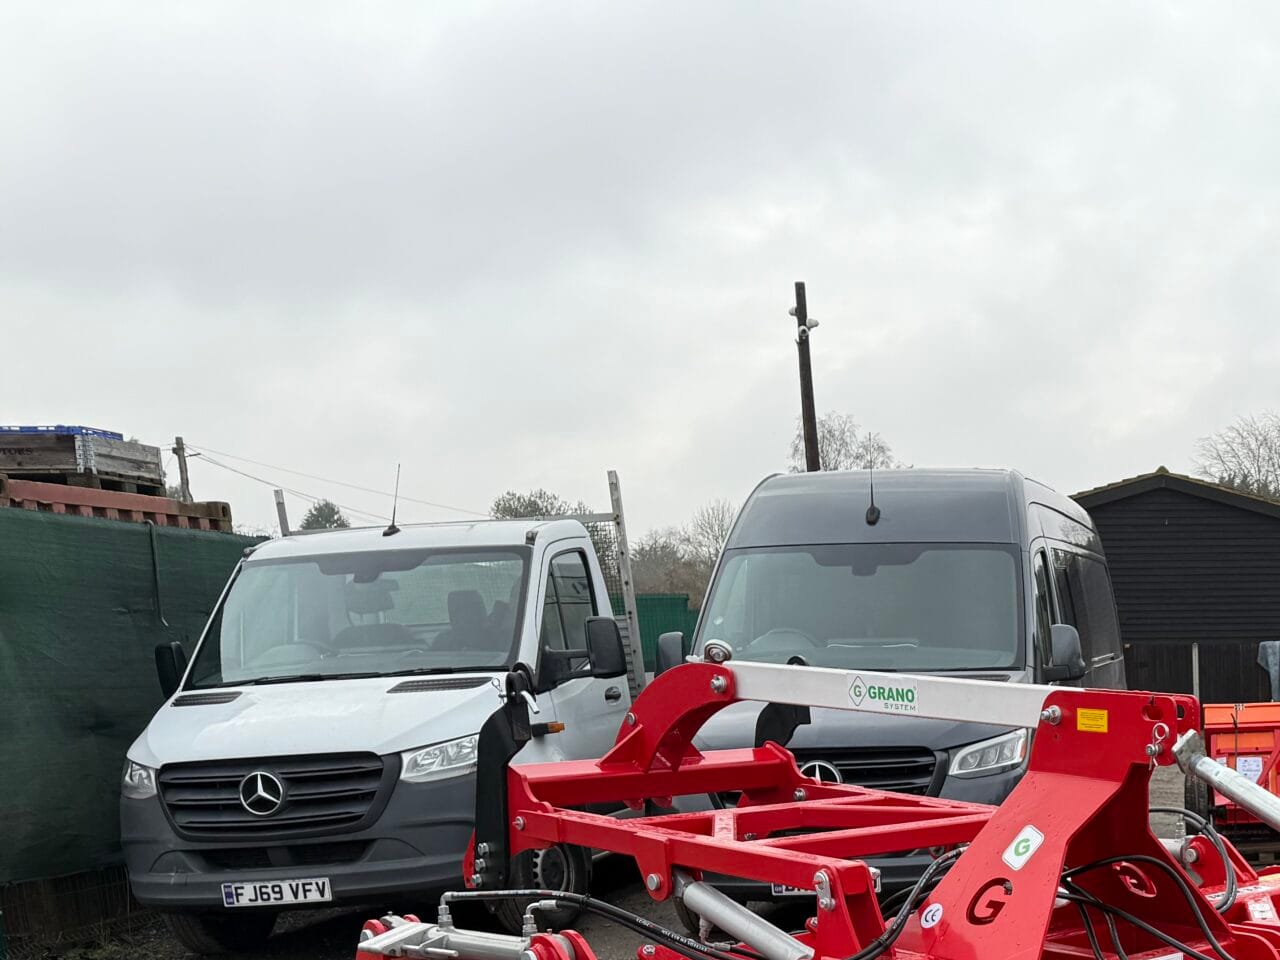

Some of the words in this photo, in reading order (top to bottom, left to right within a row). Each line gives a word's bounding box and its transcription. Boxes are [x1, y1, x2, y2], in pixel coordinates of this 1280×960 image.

[0, 447, 33, 456] TORS
[868, 685, 915, 703] GRANO
[884, 702, 916, 711] SYSTEM
[1014, 838, 1031, 857] G
[234, 884, 284, 903] FJ69
[289, 881, 326, 900] VFV
[966, 877, 1013, 926] G
